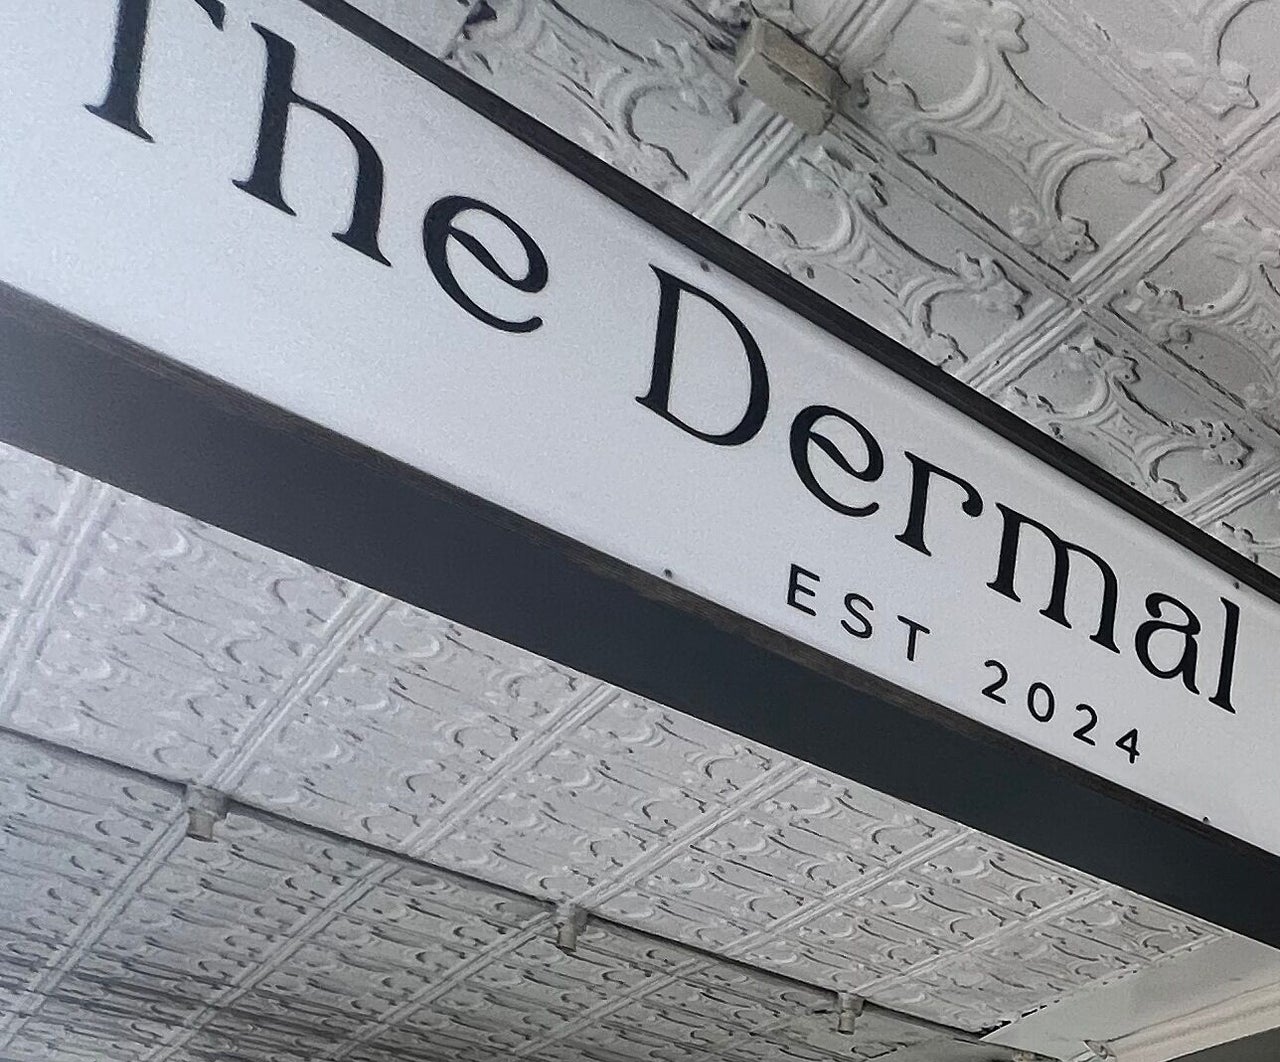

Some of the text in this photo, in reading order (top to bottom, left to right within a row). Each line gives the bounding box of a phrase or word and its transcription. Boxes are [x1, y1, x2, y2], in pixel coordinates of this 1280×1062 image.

[84, 0, 549, 334] The
[633, 262, 1240, 716] Dermal
[786, 563, 1141, 765] EST 2024
